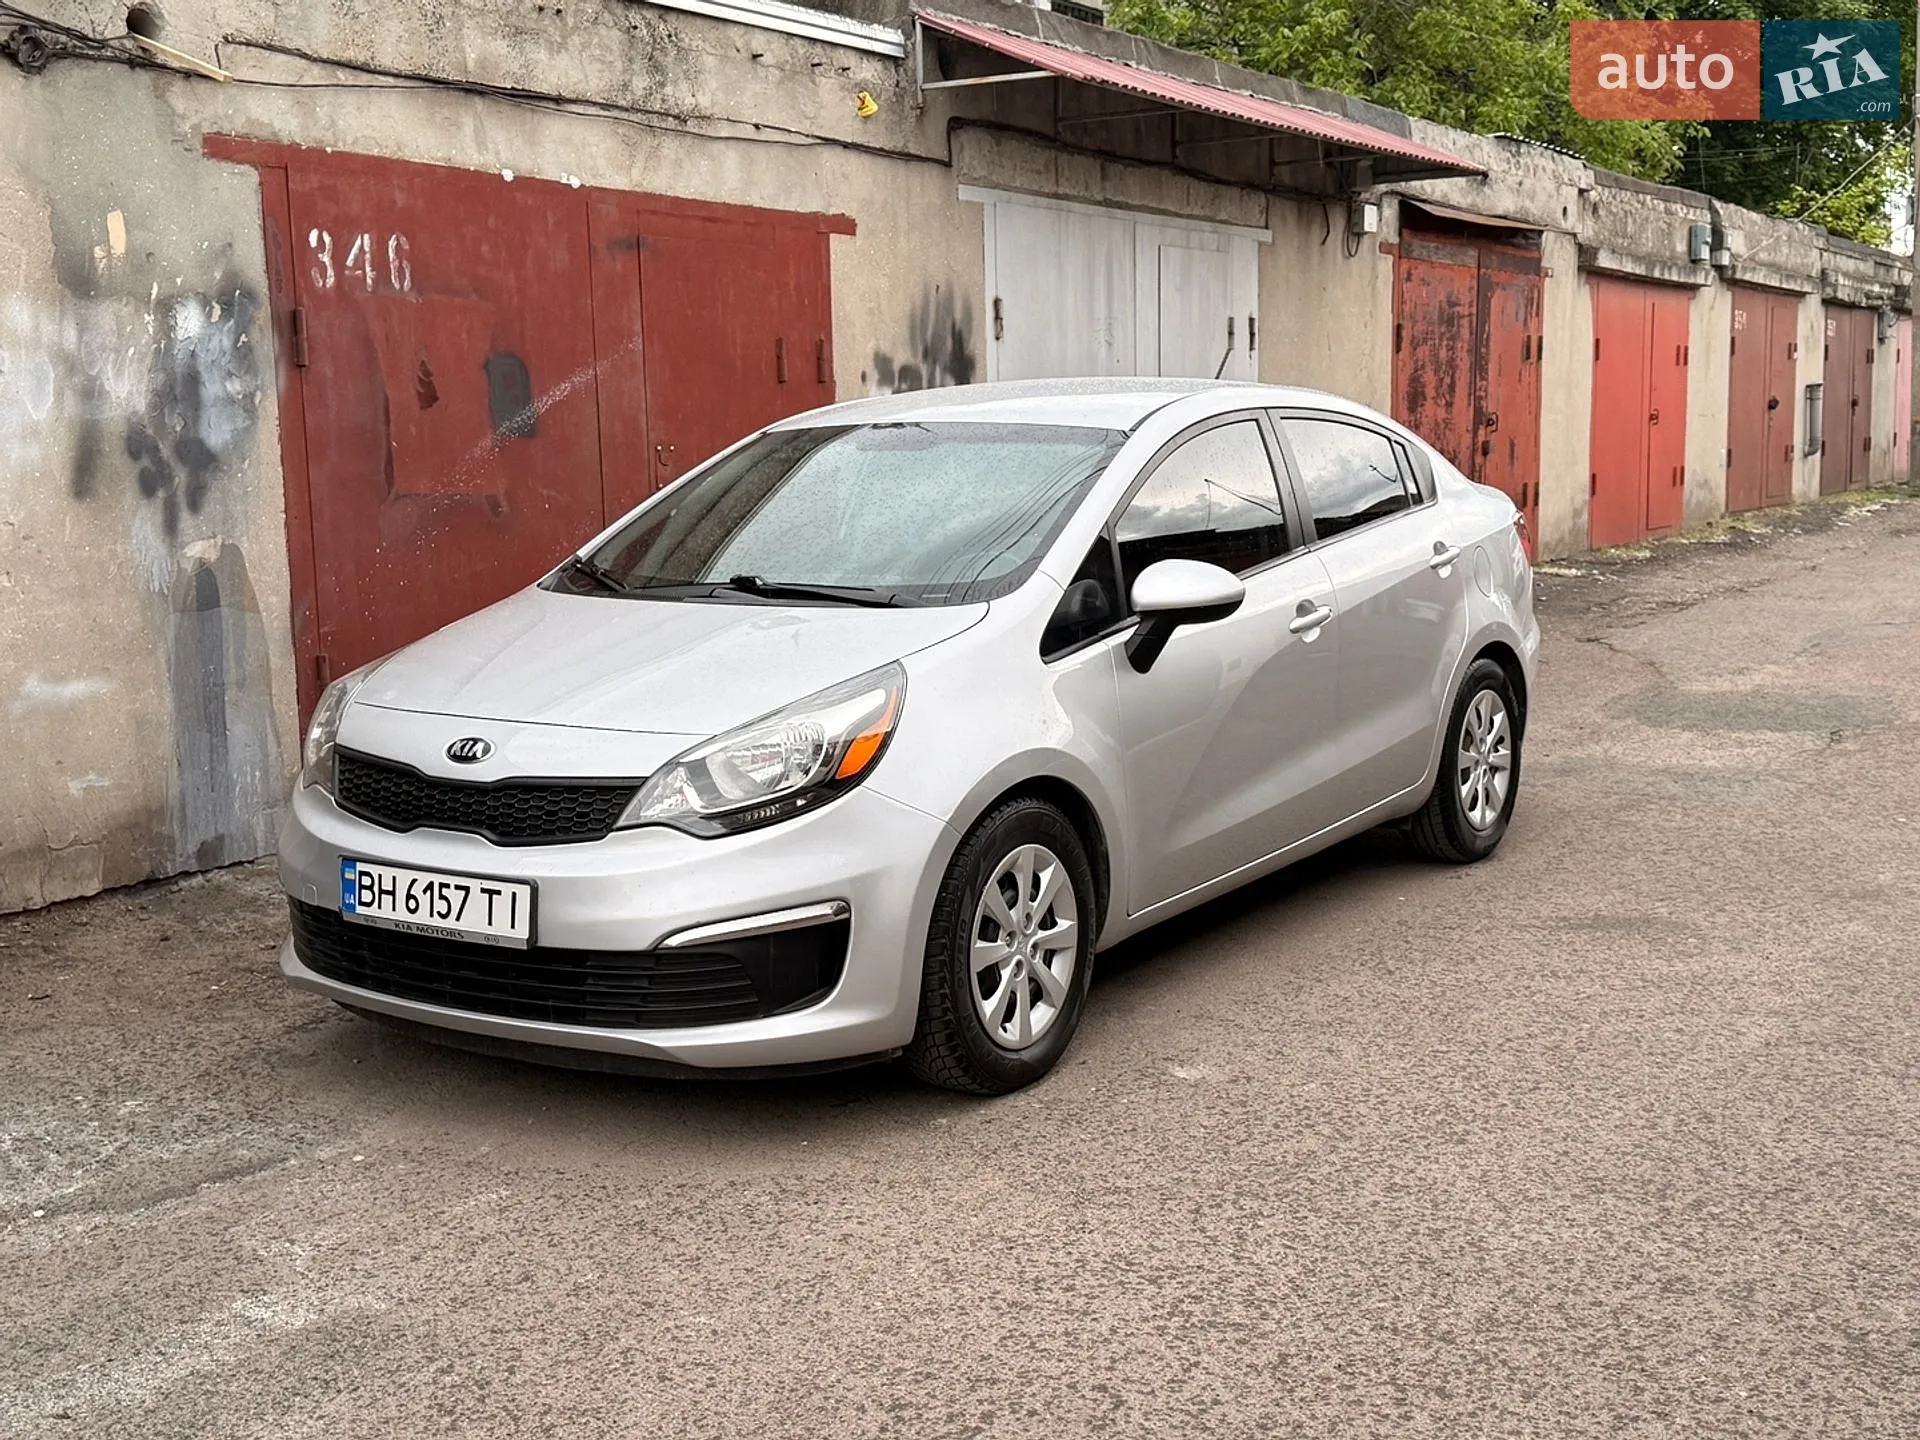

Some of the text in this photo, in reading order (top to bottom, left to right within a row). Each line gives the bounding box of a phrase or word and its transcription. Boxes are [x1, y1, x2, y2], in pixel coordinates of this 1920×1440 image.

[308, 228, 412, 292] 346
[449, 740, 485, 758] KIA
[344, 892, 356, 905] UA
[358, 870, 518, 930] BH 6157 TI
[394, 922, 465, 939] KIA MOTORS
